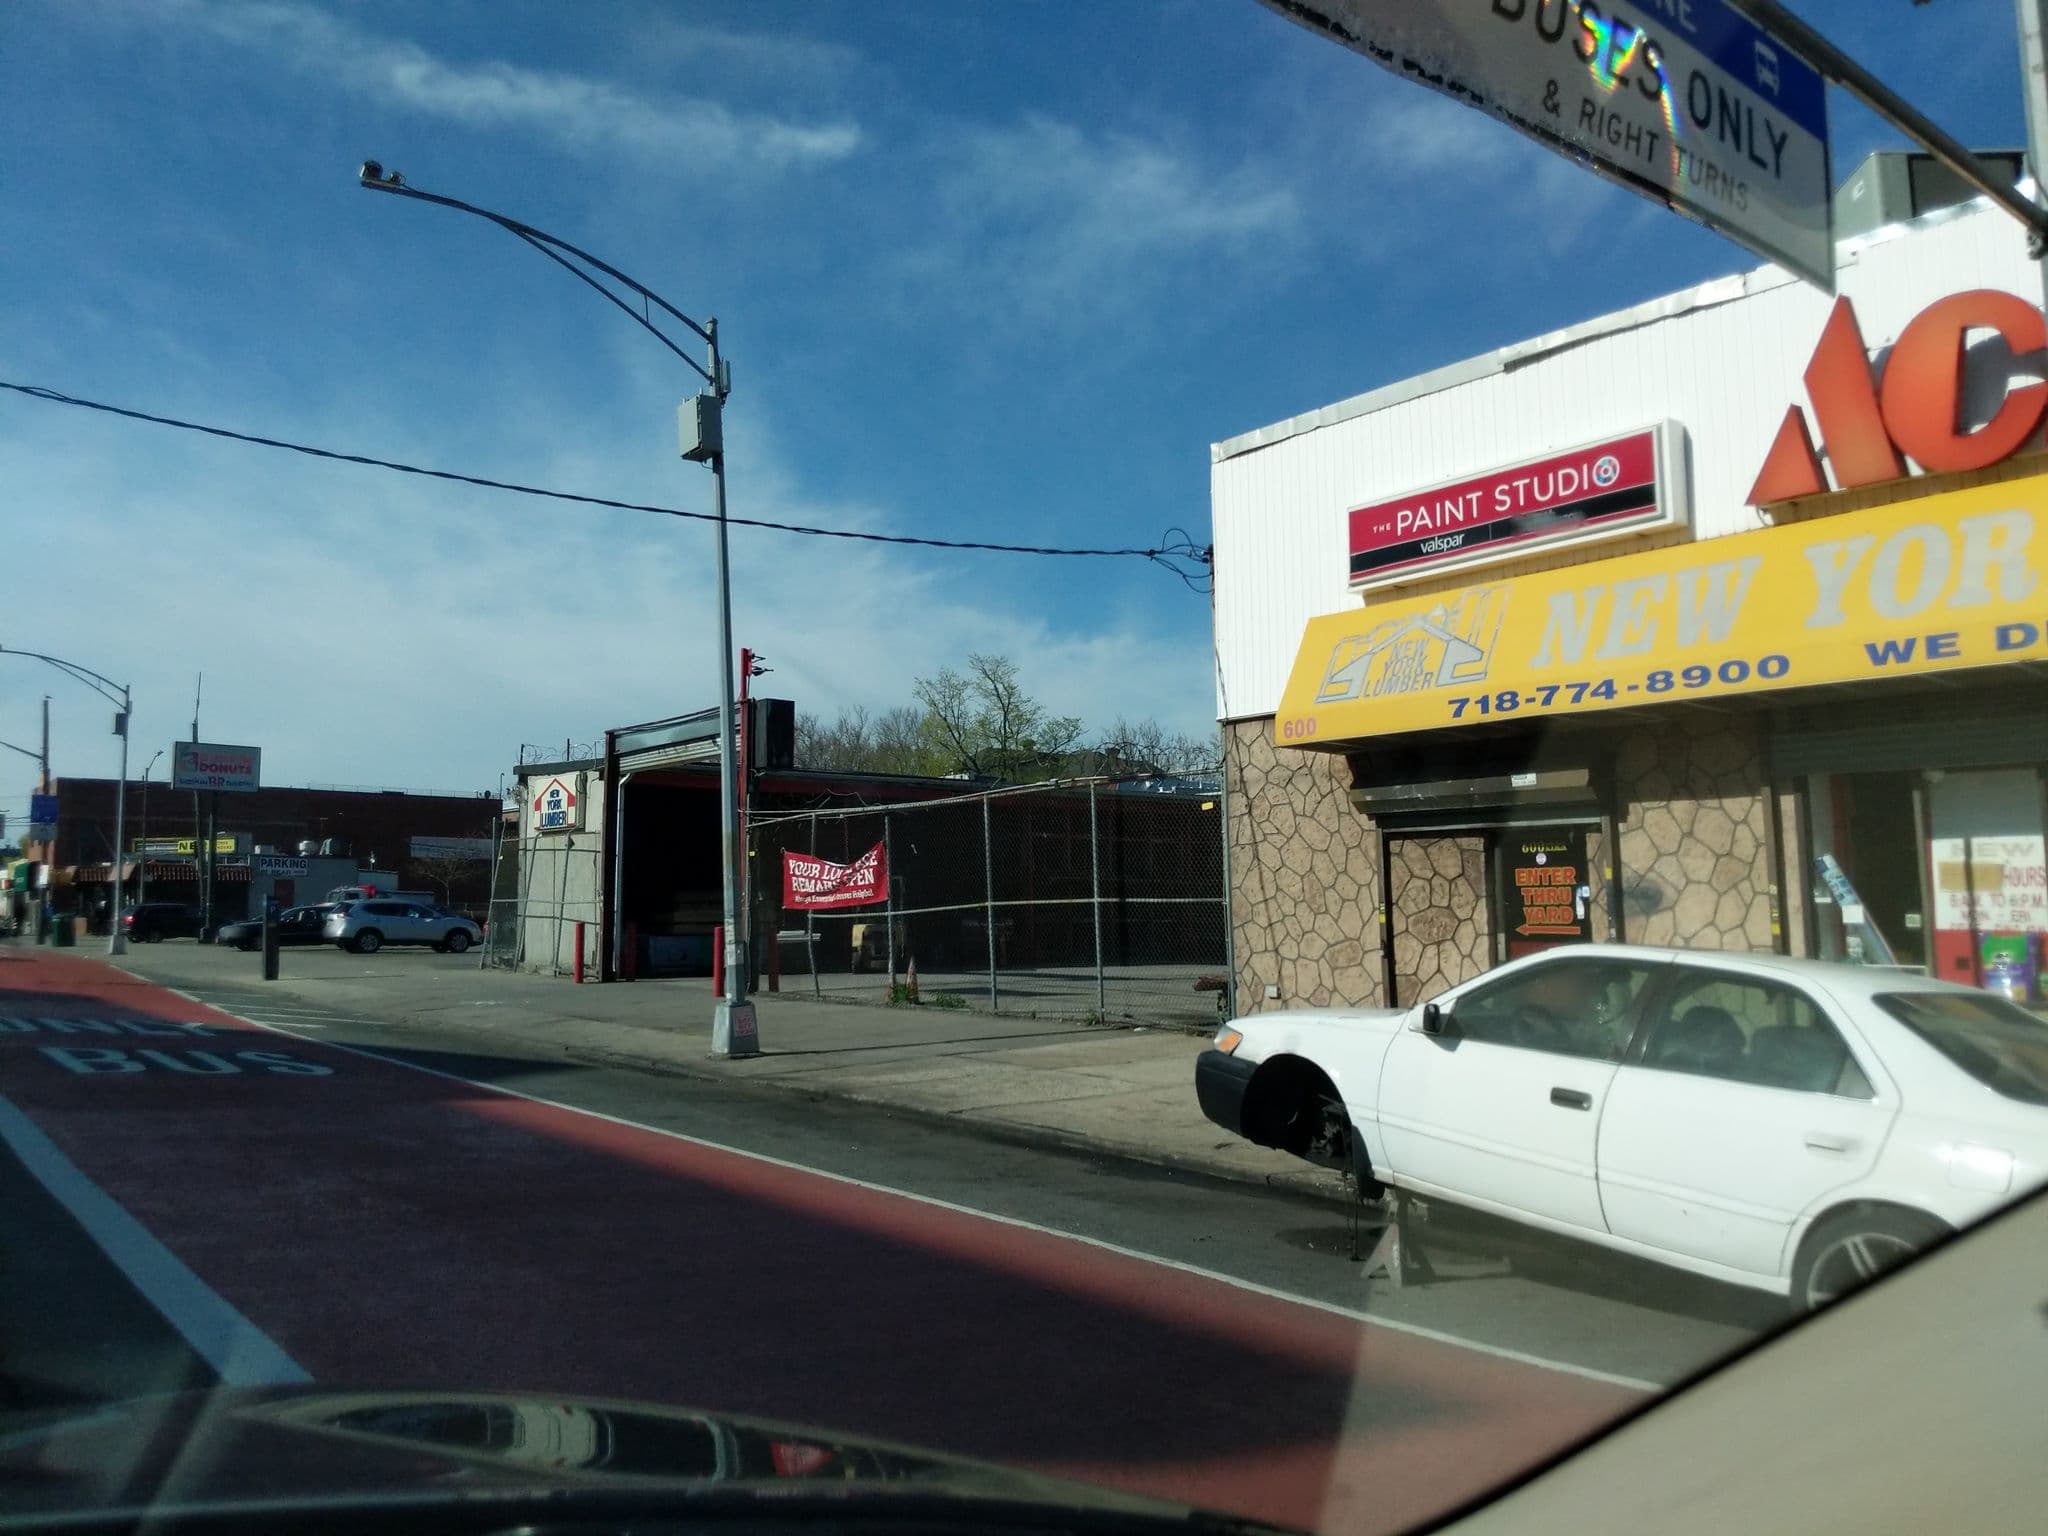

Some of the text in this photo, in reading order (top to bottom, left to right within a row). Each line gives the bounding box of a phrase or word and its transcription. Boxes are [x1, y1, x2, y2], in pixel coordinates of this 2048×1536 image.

[1688, 69, 1788, 180] ONLY
[1542, 79, 1749, 212] & RIGHT TURNS
[1744, 288, 2048, 505] AC
[1372, 456, 1620, 536] THE PAINT STUDIO
[1420, 533, 1465, 553] valspar
[1528, 556, 1762, 669] NEW
[1391, 638, 1430, 660] NEW
[1864, 620, 2048, 666] WE D
[1384, 655, 1428, 678] YORK
[1363, 671, 1434, 697] LUMBER
[1447, 654, 1791, 719] 718-774-8900
[1283, 717, 1317, 739] 600
[547, 799, 562, 811] YORK
[541, 811, 567, 827] LUMBER
[260, 857, 308, 869] PARKING
[788, 859, 819, 878] YOUR
[1515, 867, 1577, 886] ENTER
[1521, 886, 1572, 905] THRU
[1523, 905, 1575, 925] YARD
[37, 1047, 334, 1075] BUS
